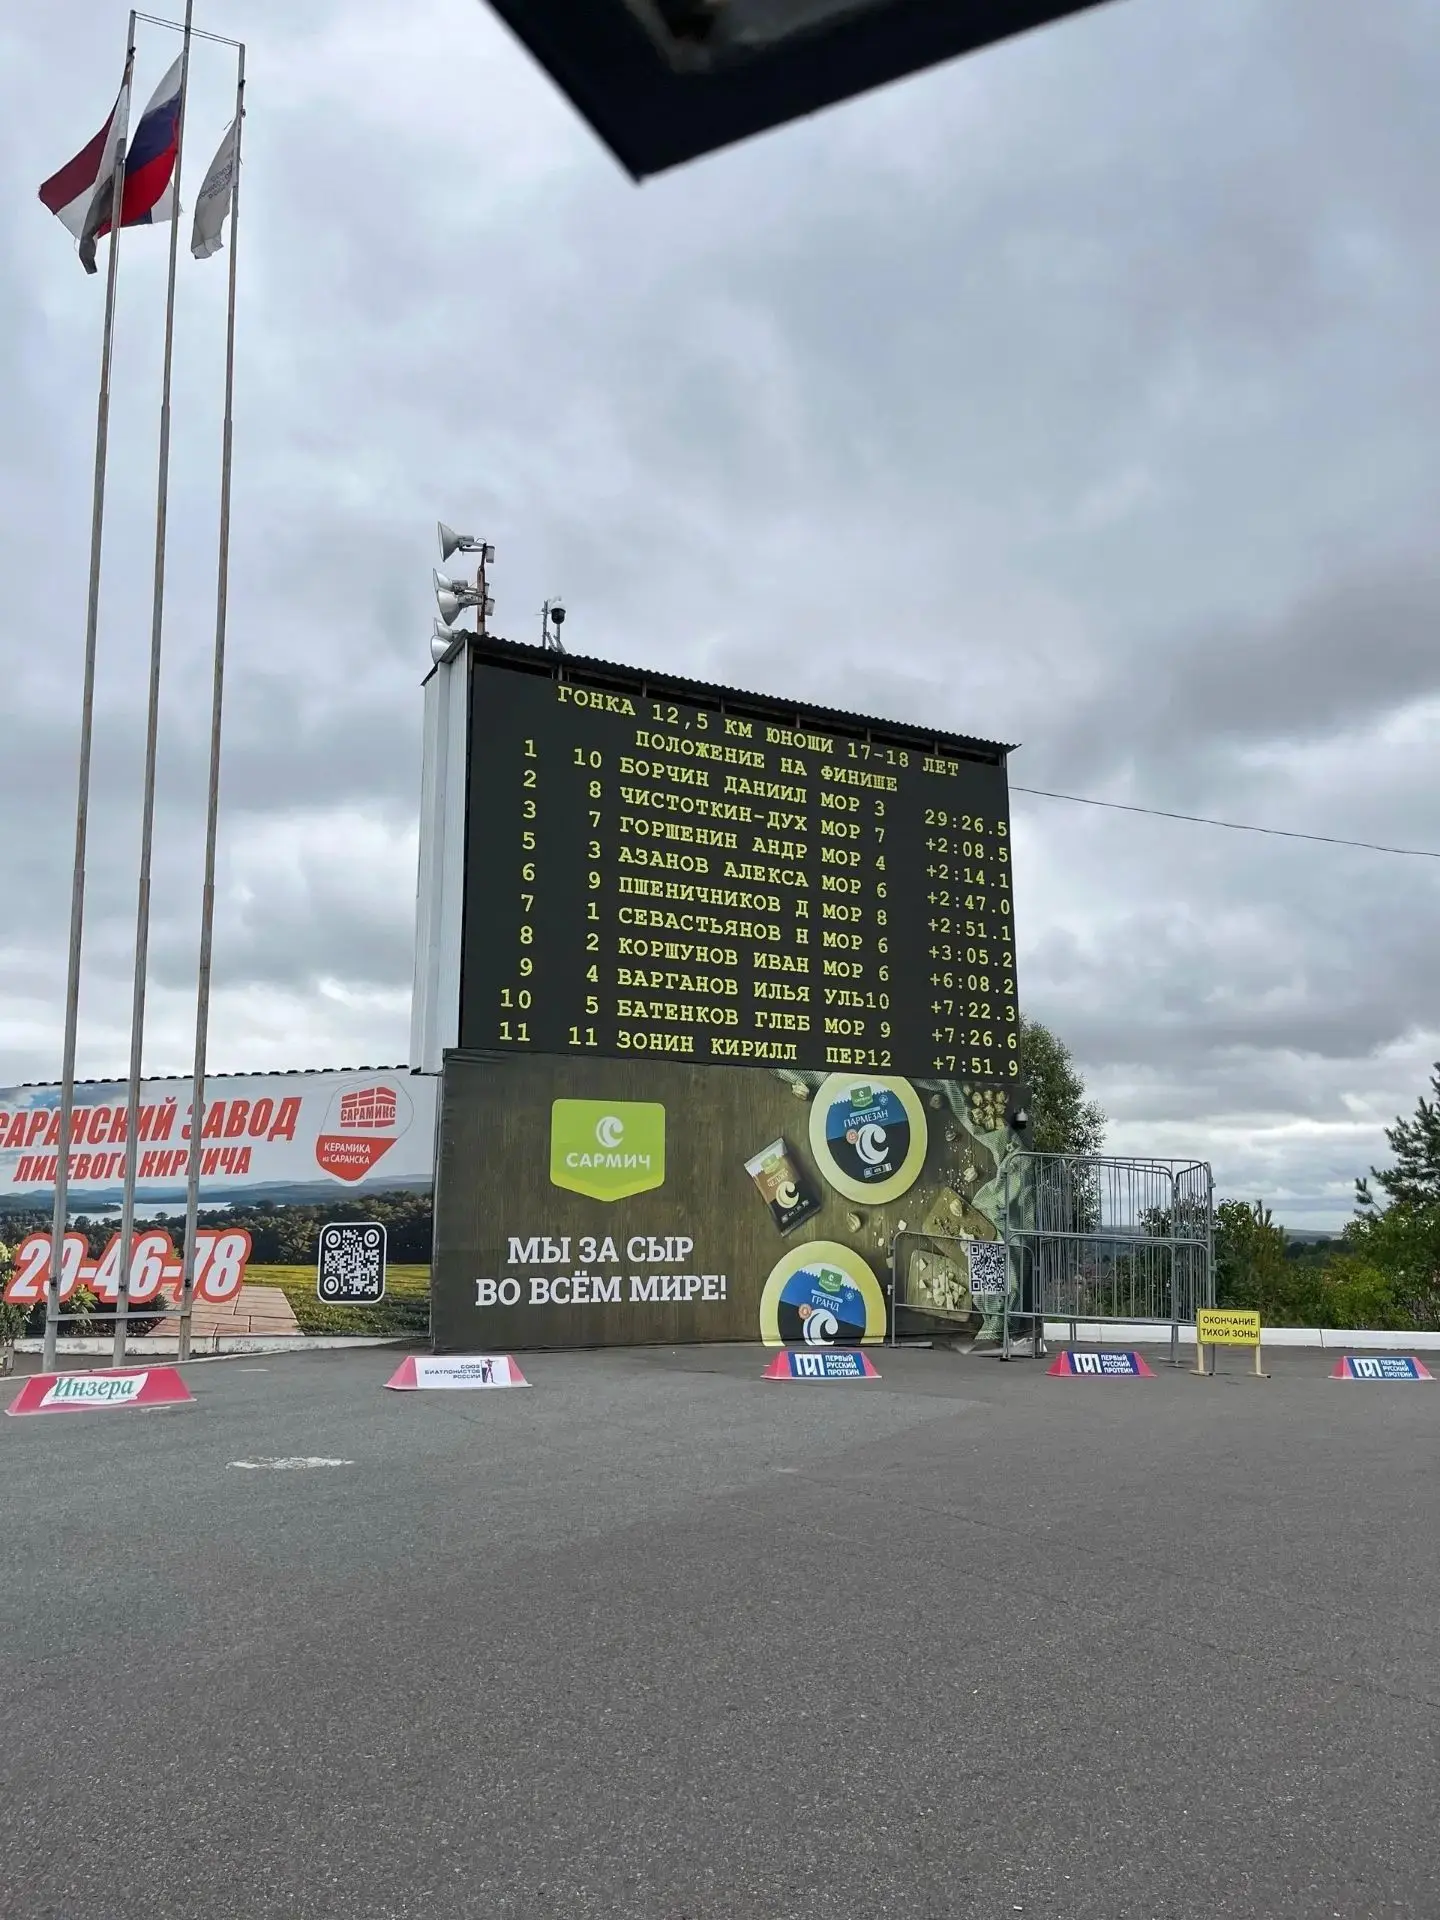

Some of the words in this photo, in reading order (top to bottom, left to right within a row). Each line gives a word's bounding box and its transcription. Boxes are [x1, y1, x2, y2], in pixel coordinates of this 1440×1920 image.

[557, 686, 636, 715] ГОНКА
[652, 704, 708, 730] 12,5
[724, 718, 753, 738] КМ
[766, 726, 834, 754] ЮНОШИ
[848, 743, 908, 767] 17-18
[922, 757, 959, 777] ЛЕТ
[636, 731, 764, 768] ПОЛОЖЕНИЕ
[781, 758, 807, 776] НА
[821, 766, 897, 791] ФИНИШЕ
[525, 740, 536, 757] 1
[574, 749, 601, 768] 10
[620, 757, 709, 787] БОРЧИН
[724, 776, 806, 803] ДАНИИЛ
[821, 792, 859, 811] МОР
[875, 801, 884, 816] 3
[925, 809, 1005, 836] 29:26.5
[524, 770, 536, 788] 2
[590, 781, 601, 798] 8
[620, 787, 807, 831] ЧИСТОТКИН-ДУХ
[821, 820, 860, 839] МОР
[875, 828, 884, 842] 7
[926, 838, 1006, 862] +2:08.5
[523, 800, 536, 818] 3
[589, 811, 600, 827] 7
[620, 817, 737, 848] ГОРШЕНИН
[752, 837, 807, 860] АНДР
[822, 847, 860, 866] МОР
[876, 856, 885, 870] 4
[927, 864, 1007, 888] +2:14.1
[523, 832, 535, 849] 5
[589, 841, 600, 858] 3
[618, 847, 708, 873] АЗАНОВ
[724, 862, 808, 887] АЛЕКСА
[822, 875, 861, 894] МОР
[877, 882, 886, 898] 6
[928, 891, 1008, 914] +2:47.0
[523, 863, 535, 881] 6
[589, 872, 600, 889] 9
[619, 877, 780, 912] ПШЕНИЧНИКОВ
[796, 900, 808, 918] Д
[823, 903, 862, 922] МОР
[877, 910, 887, 925] 8
[928, 918, 1010, 941] +2:51.1
[521, 894, 533, 911] 7
[588, 902, 599, 920] 1
[619, 908, 781, 940] СЕВАСТЬЯНОВ
[796, 928, 808, 944] Н
[823, 932, 862, 950] МОР
[878, 938, 887, 953] 6
[929, 945, 1011, 967] +3:05.2
[520, 926, 532, 944] 8
[587, 933, 598, 951] 2
[619, 938, 738, 965] КОРШУНОВ
[754, 952, 809, 973] ИВАН
[823, 960, 863, 978] МОР
[879, 965, 888, 981] 6
[930, 973, 1013, 994] +6:08.2
[520, 958, 532, 976] 9
[587, 965, 598, 982] 4
[618, 968, 738, 995] ВАРГАНОВ
[754, 982, 809, 1002] ИЛЬЯ
[931, 1000, 1014, 1021] +7:22.3
[501, 989, 531, 1009] 10
[586, 996, 598, 1014] 5
[617, 1000, 738, 1025] БАТЕНКОВ
[755, 1012, 810, 1031] ГЛЕБ
[825, 1018, 864, 1035] МОР
[881, 1022, 890, 1038] 9
[932, 1028, 1015, 1048] +7:26.6
[500, 1022, 530, 1041] 11
[569, 1027, 597, 1045] 11
[617, 1030, 694, 1052] ЗОНИН
[711, 1038, 797, 1060] КИРИЛЛ
[933, 1056, 1016, 1076] +7:51.9
[843, 1110, 889, 1128] ПАРМЕЗАН
[138, 1146, 252, 1178] КИРИЧА
[324, 1142, 371, 1153] КЕРАМИКА
[330, 1154, 370, 1164] САРАНСКА
[566, 1152, 650, 1170] САРМИЧ
[507, 1236, 571, 1264] МЫ
[578, 1236, 619, 1263] ЗА
[626, 1236, 694, 1263] СЫР
[475, 1278, 521, 1306] ВО
[528, 1270, 622, 1304] ВСЁМ
[628, 1274, 728, 1303] МИРЕ!
[811, 1295, 840, 1312] ГРАНД
[1201, 1328, 1230, 1337] ТИХОЙ
[1232, 1329, 1259, 1338] ЗОНЫ
[1202, 1316, 1257, 1326] ОКОНЧАНИЕ
[1100, 1353, 1128, 1361] ПЕРВЫЙ
[53, 1377, 134, 1400] Инзера
